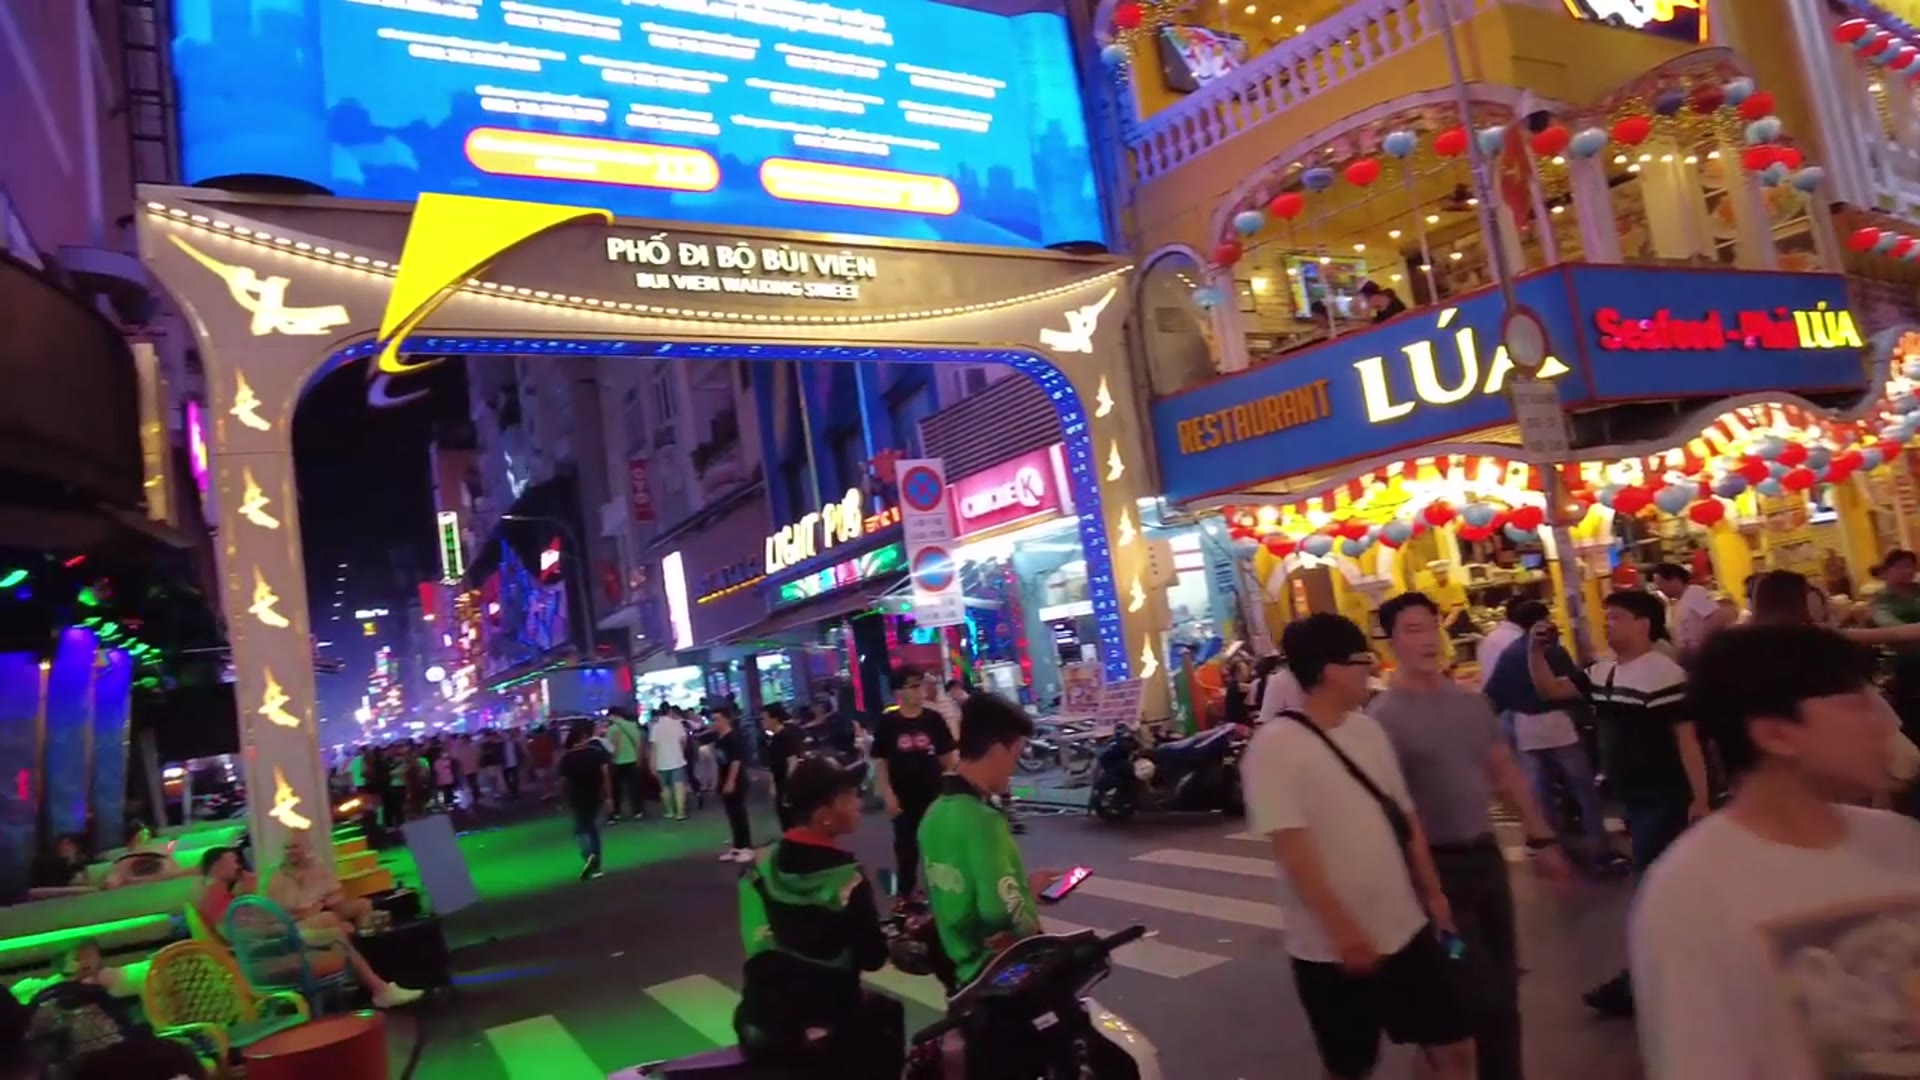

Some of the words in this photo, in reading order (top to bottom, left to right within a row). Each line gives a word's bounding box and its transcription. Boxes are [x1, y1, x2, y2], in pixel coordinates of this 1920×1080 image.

[607, 233, 671, 265] PHỐ
[678, 243, 710, 267] ĐI
[716, 241, 756, 274] BỘ
[762, 244, 809, 273] BÙI
[812, 250, 877, 281] VIỆN
[635, 272, 670, 289] BUI
[672, 274, 720, 291] VIEN
[722, 277, 803, 297] WALKING
[803, 282, 859, 300] STREET
[1177, 379, 1331, 455] RESTAURANT
[1353, 307, 1570, 423] LÚA
